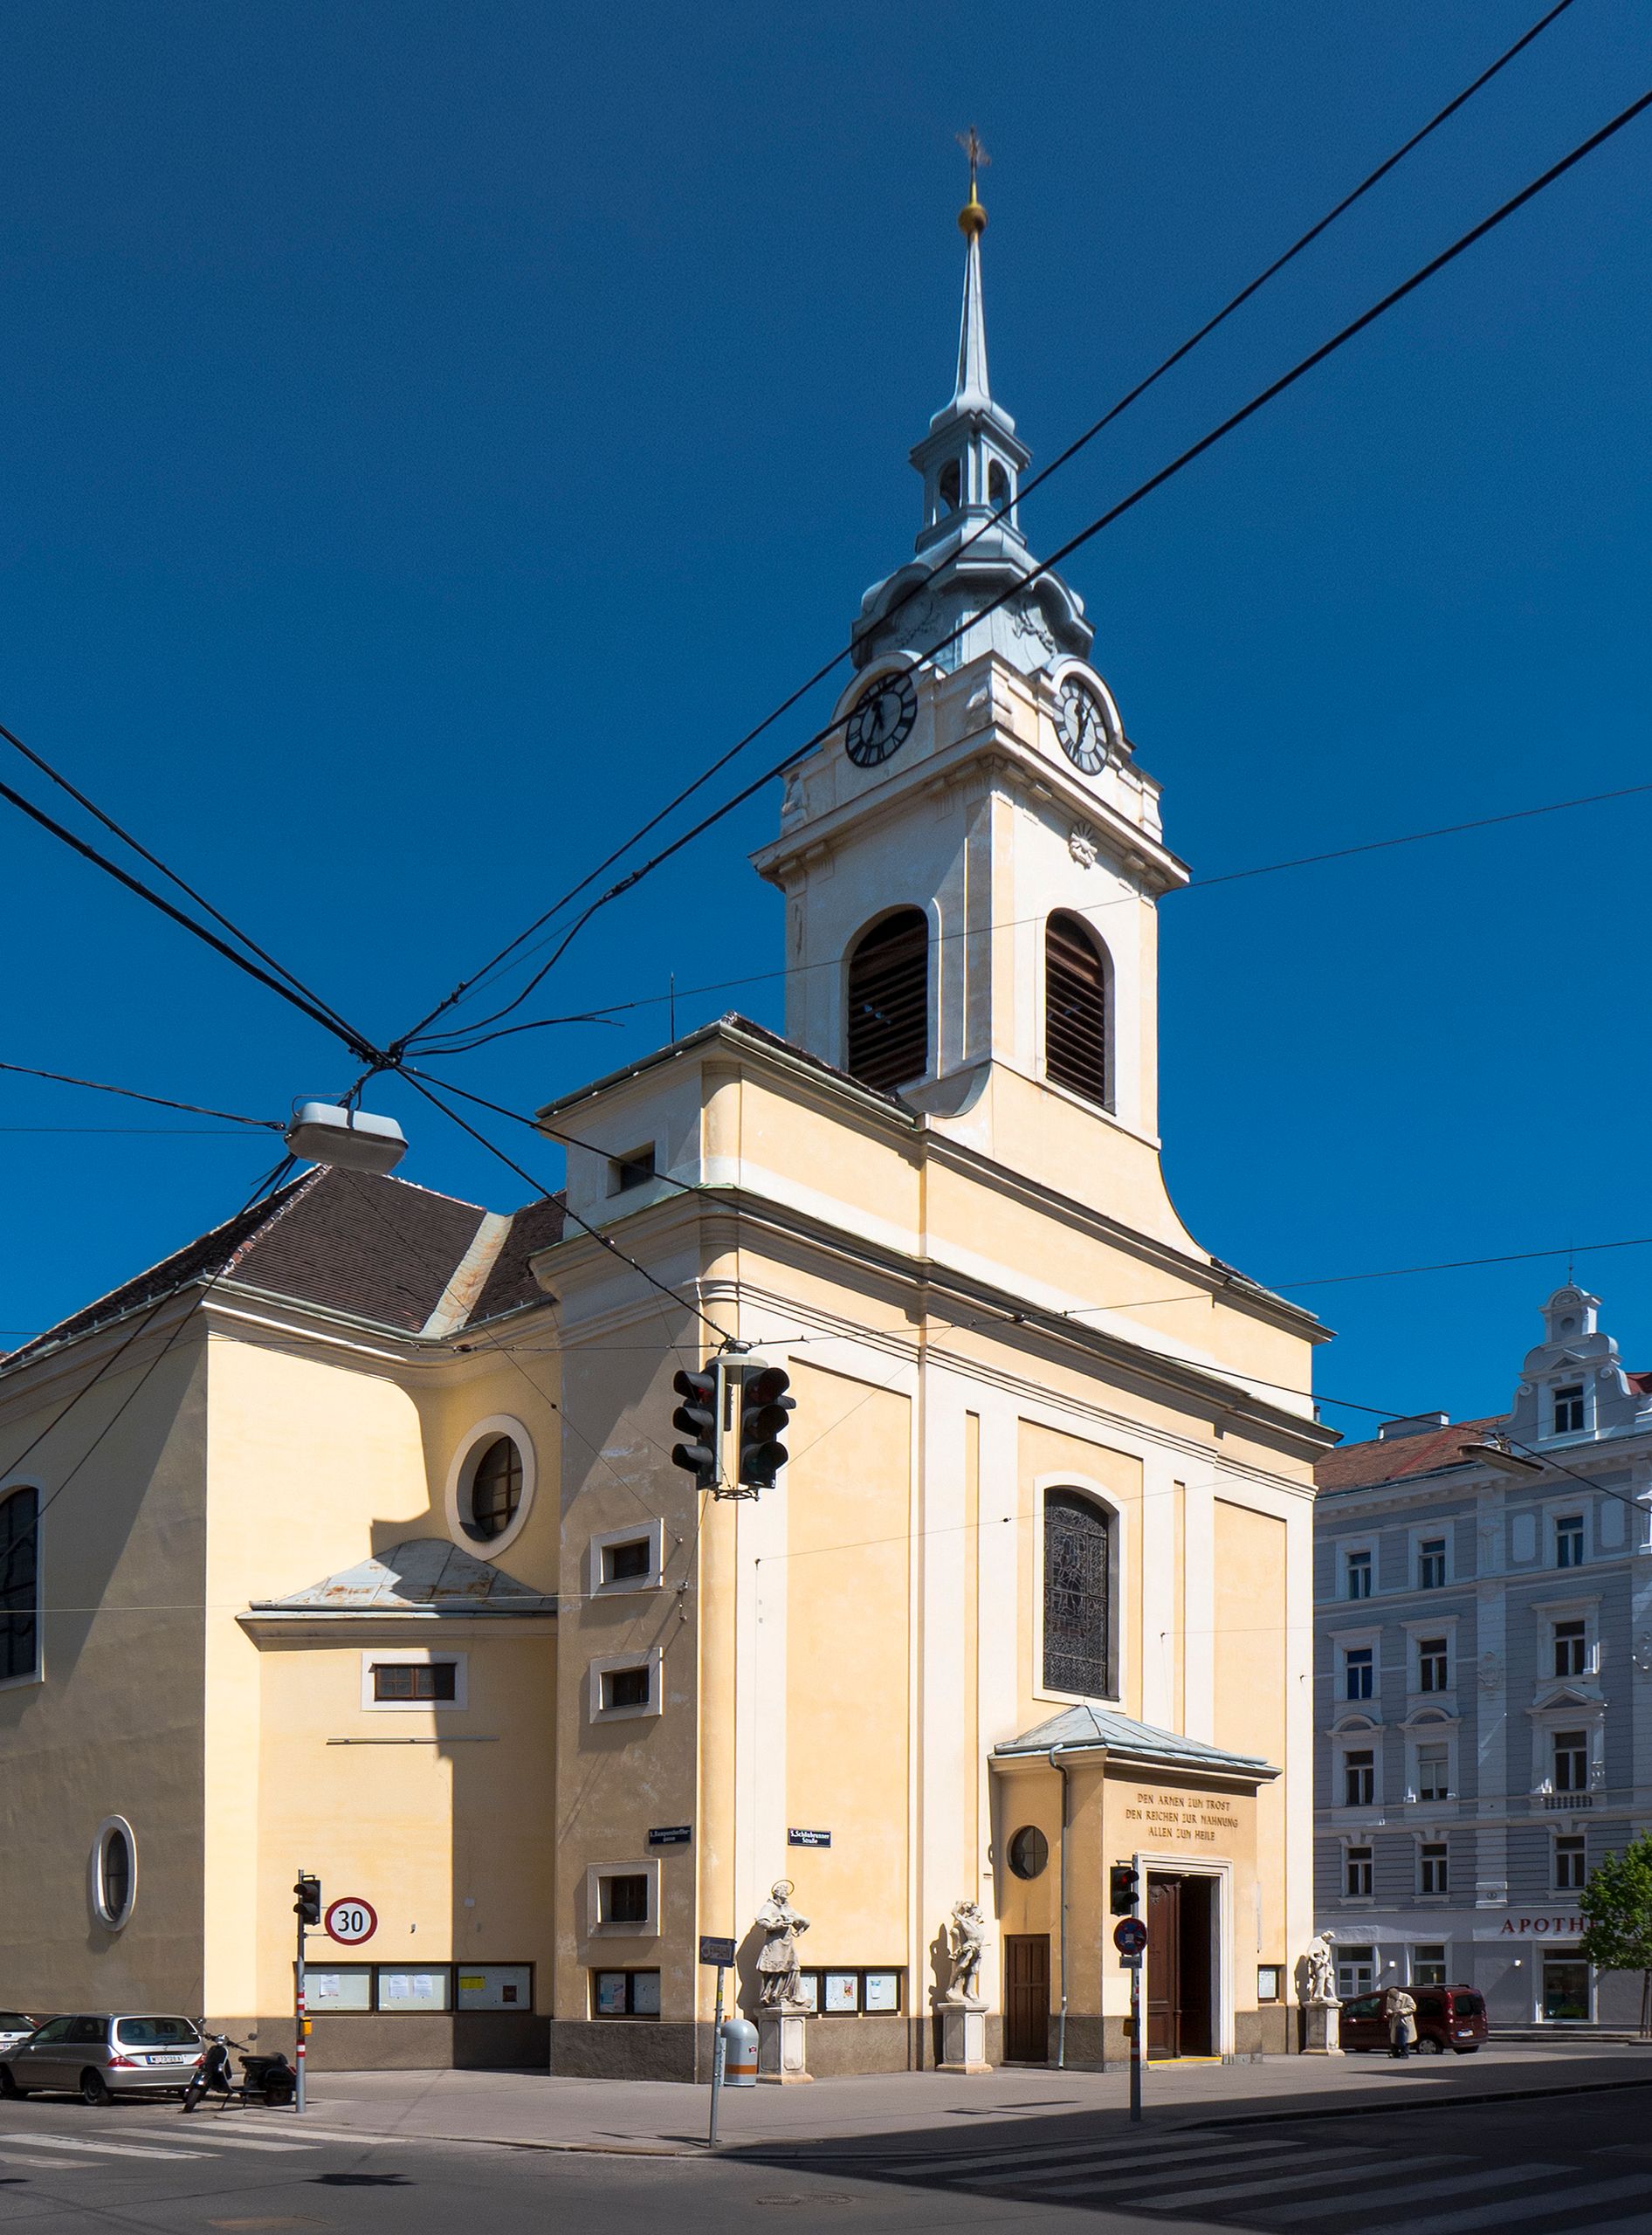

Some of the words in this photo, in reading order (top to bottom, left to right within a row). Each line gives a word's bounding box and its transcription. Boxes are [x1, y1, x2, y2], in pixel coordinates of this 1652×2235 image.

[1138, 1793, 1153, 1805] DEN
[1159, 1796, 1184, 1808] ARMEN
[1187, 1798, 1203, 1809] ZUM
[1206, 1799, 1230, 1812] TROST
[1125, 1809, 1142, 1819] DEN
[1146, 1811, 1179, 1823] REICHEN
[1182, 1813, 1197, 1824] ZUR
[1201, 1815, 1238, 1828] MAHNUNG
[1148, 1826, 1173, 1838] ALLEN
[1176, 1828, 1192, 1840] ZUM
[1194, 1830, 1215, 1841] HEILE
[337, 1910, 363, 1932] 30
